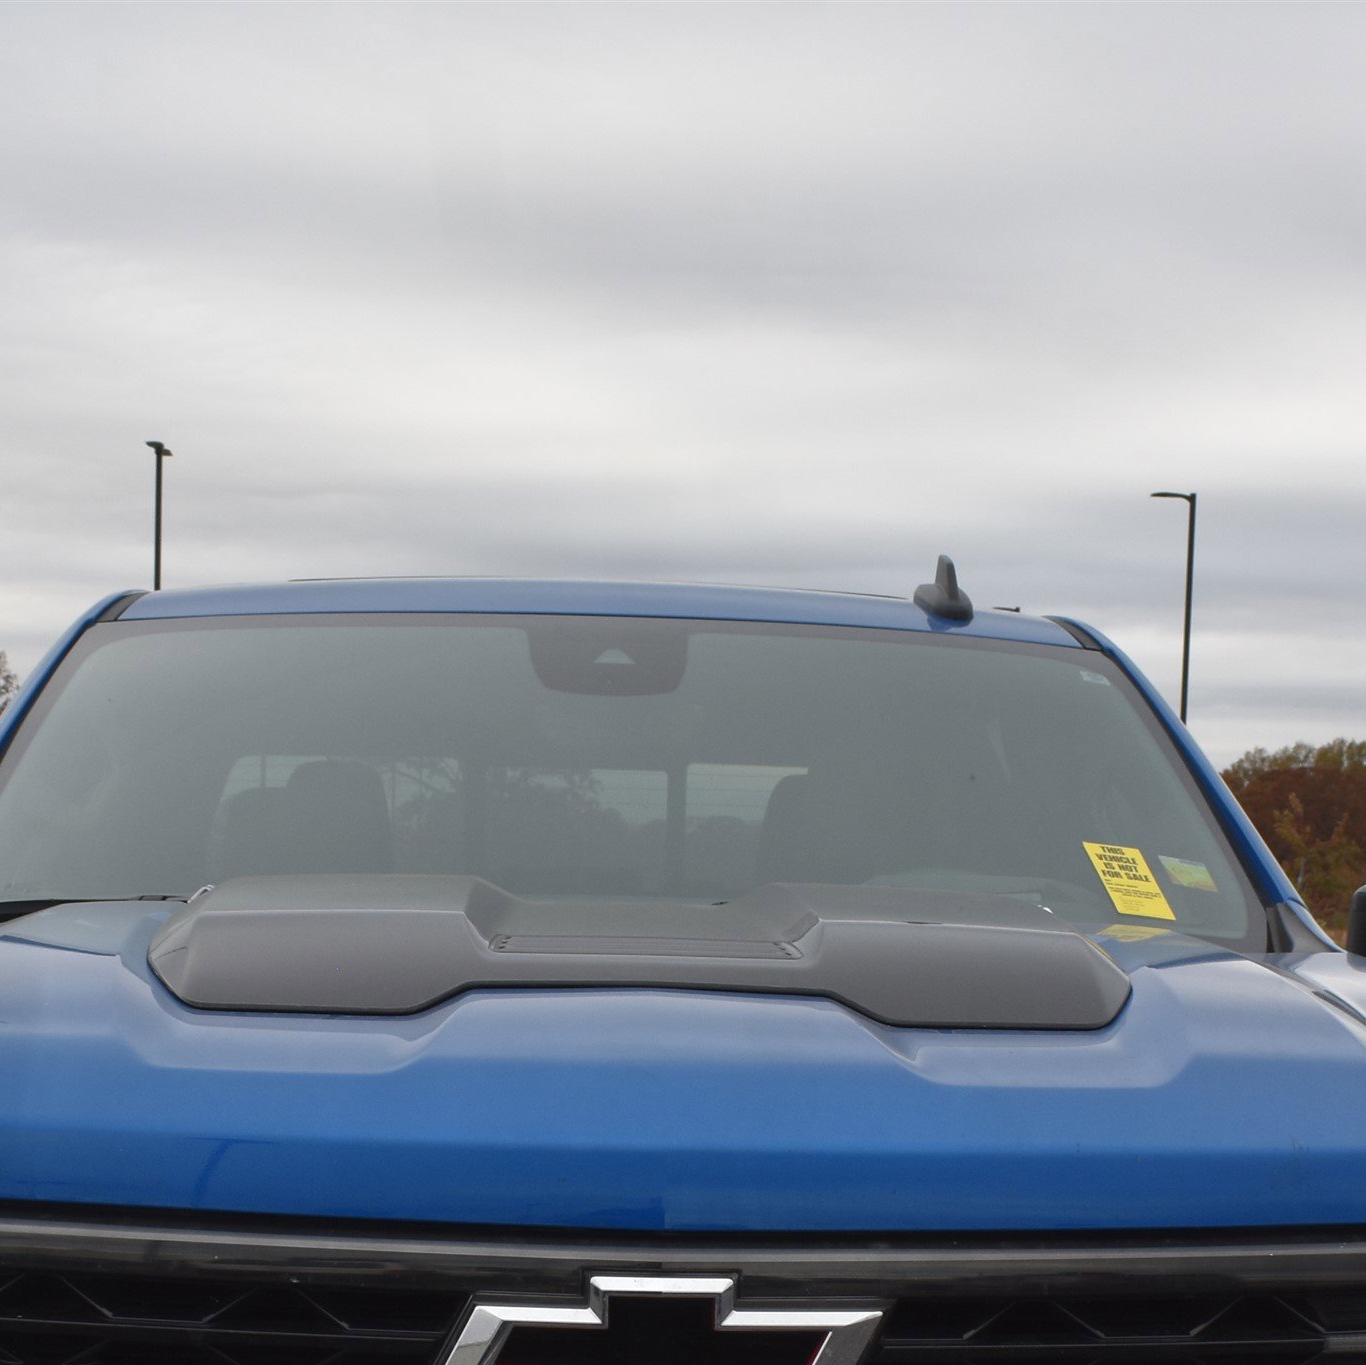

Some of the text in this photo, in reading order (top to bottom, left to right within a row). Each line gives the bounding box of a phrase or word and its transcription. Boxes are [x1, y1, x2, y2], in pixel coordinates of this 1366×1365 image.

[1100, 846, 1125, 855] THIS
[1095, 853, 1138, 865] VEHICLE
[1103, 862, 1139, 873] IS NOT
[1101, 869, 1151, 882] FOR SALE
